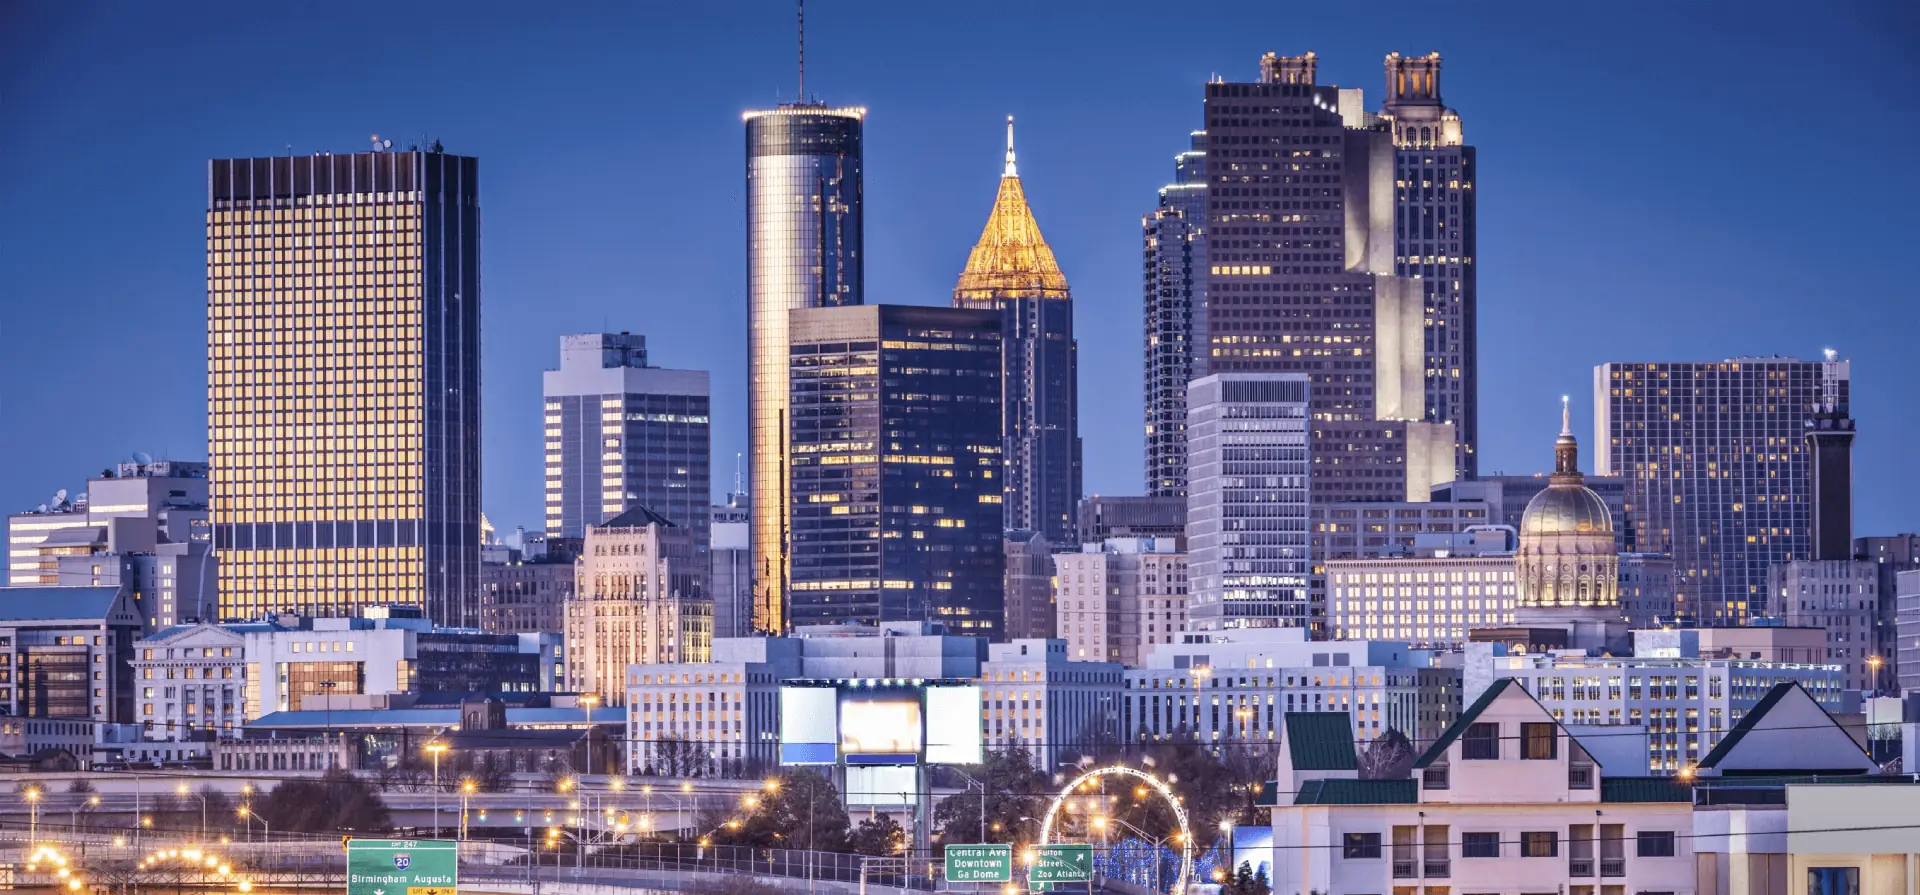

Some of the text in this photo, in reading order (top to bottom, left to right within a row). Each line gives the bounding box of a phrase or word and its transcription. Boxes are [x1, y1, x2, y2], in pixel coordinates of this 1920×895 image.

[950, 848, 1007, 857] Central Ave
[1038, 849, 1063, 857] Fulton
[396, 858, 409, 867] 20
[954, 859, 1002, 868] Downtown
[1038, 859, 1064, 868] Street
[957, 870, 1000, 879] Ga Dome
[1037, 870, 1086, 878] Zoo Atlanta
[351, 874, 452, 885] Birmingham Augusta
